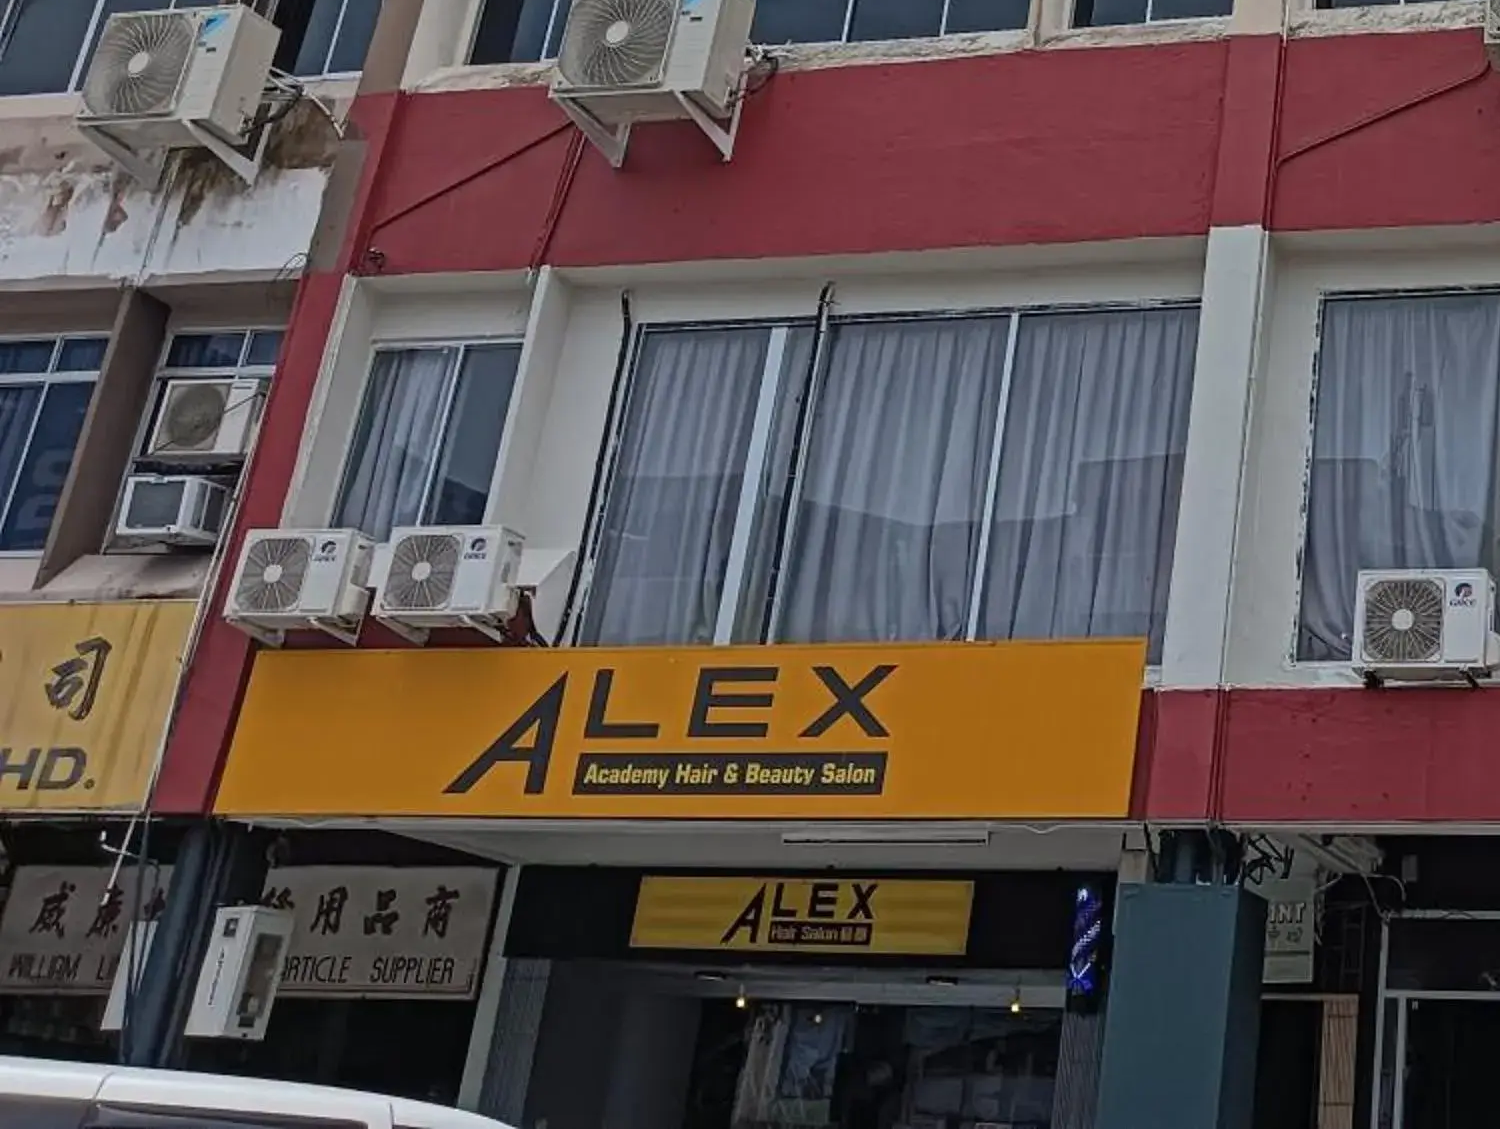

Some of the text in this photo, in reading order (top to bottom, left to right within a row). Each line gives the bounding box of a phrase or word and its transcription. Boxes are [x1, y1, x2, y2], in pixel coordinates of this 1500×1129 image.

[45, 636, 113, 721] 司
[443, 664, 898, 794] ALEX
[583, 761, 876, 789] Academy Hair & Beauty Salon
[720, 882, 878, 944] ALEX
[370, 956, 455, 984] SUPPLIER
